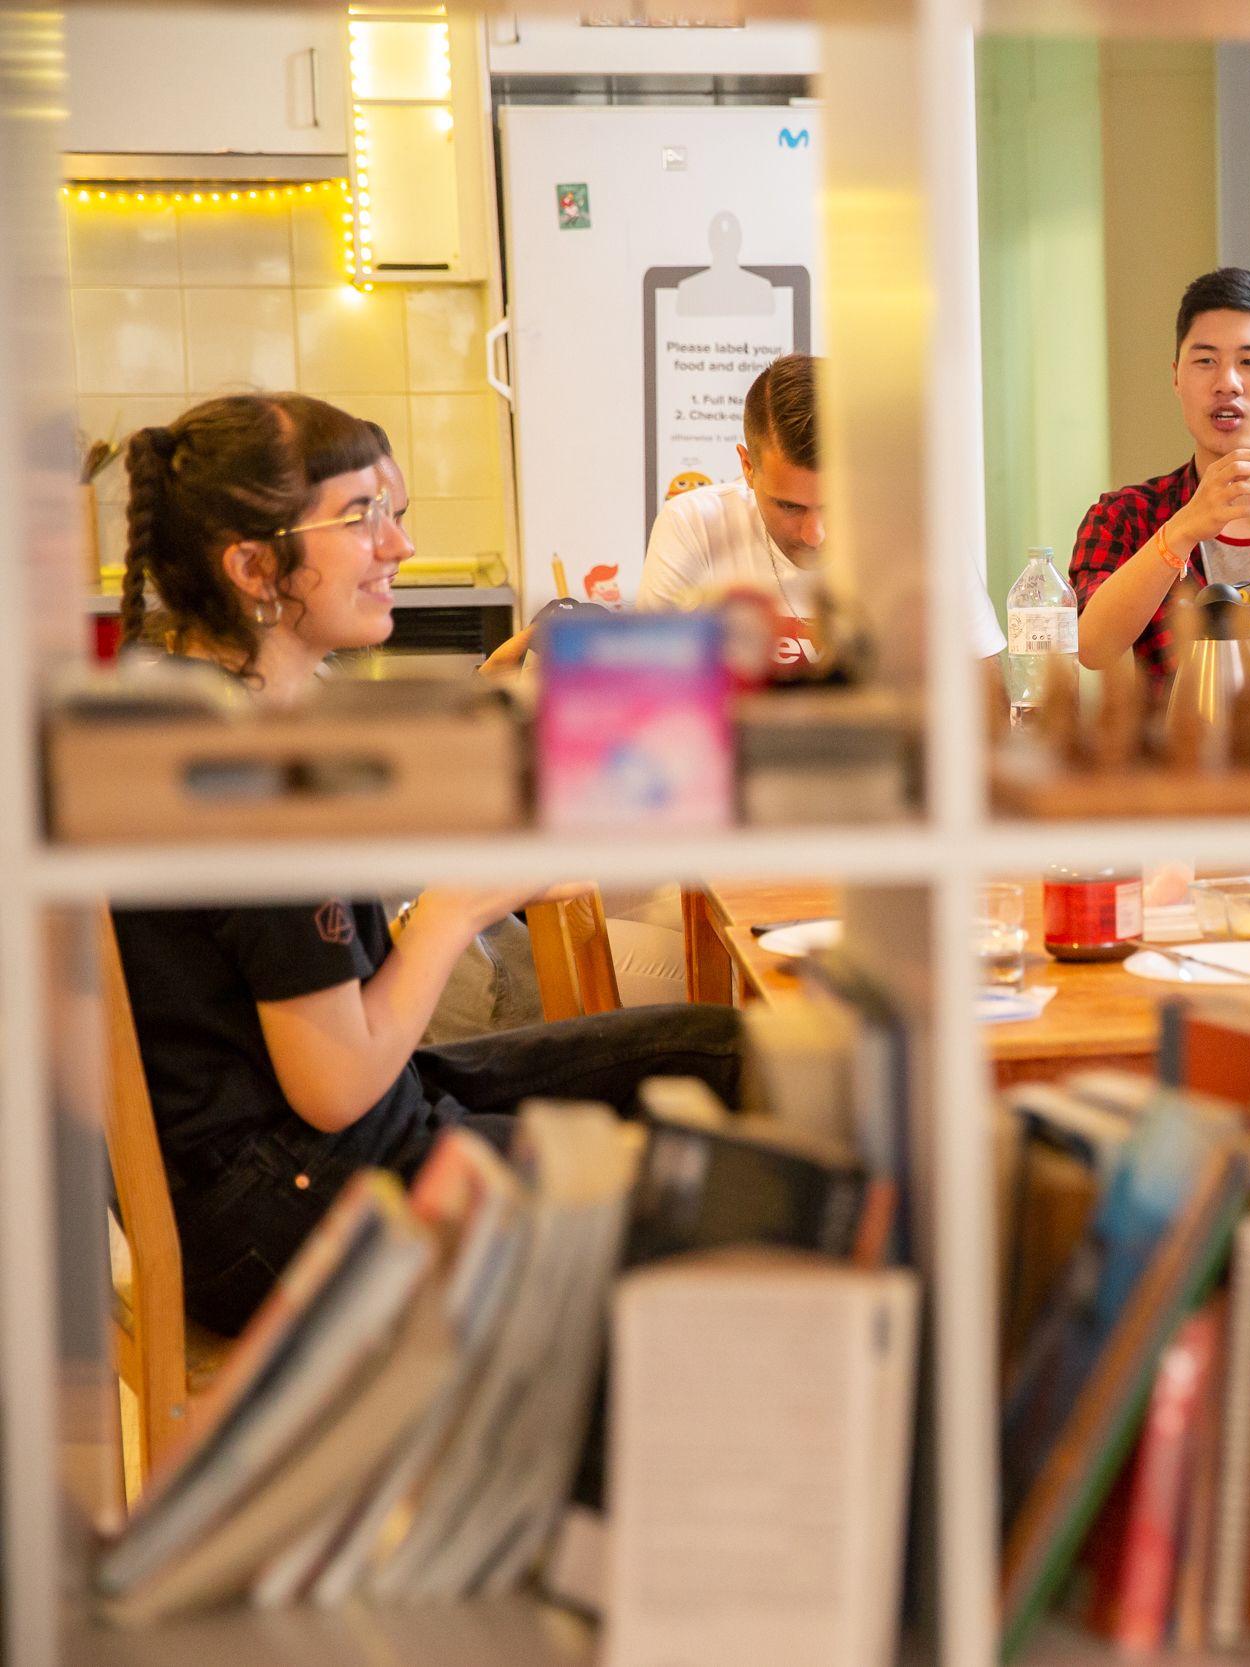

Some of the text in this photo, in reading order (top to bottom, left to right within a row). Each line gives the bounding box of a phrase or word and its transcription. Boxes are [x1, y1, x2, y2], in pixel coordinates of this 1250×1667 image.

[666, 341, 782, 357] Please label your
[674, 360, 704, 372] food
[709, 361, 734, 372] and
[703, 394, 725, 405] Full
[728, 395, 743, 405] Na
[675, 409, 686, 421] 2.
